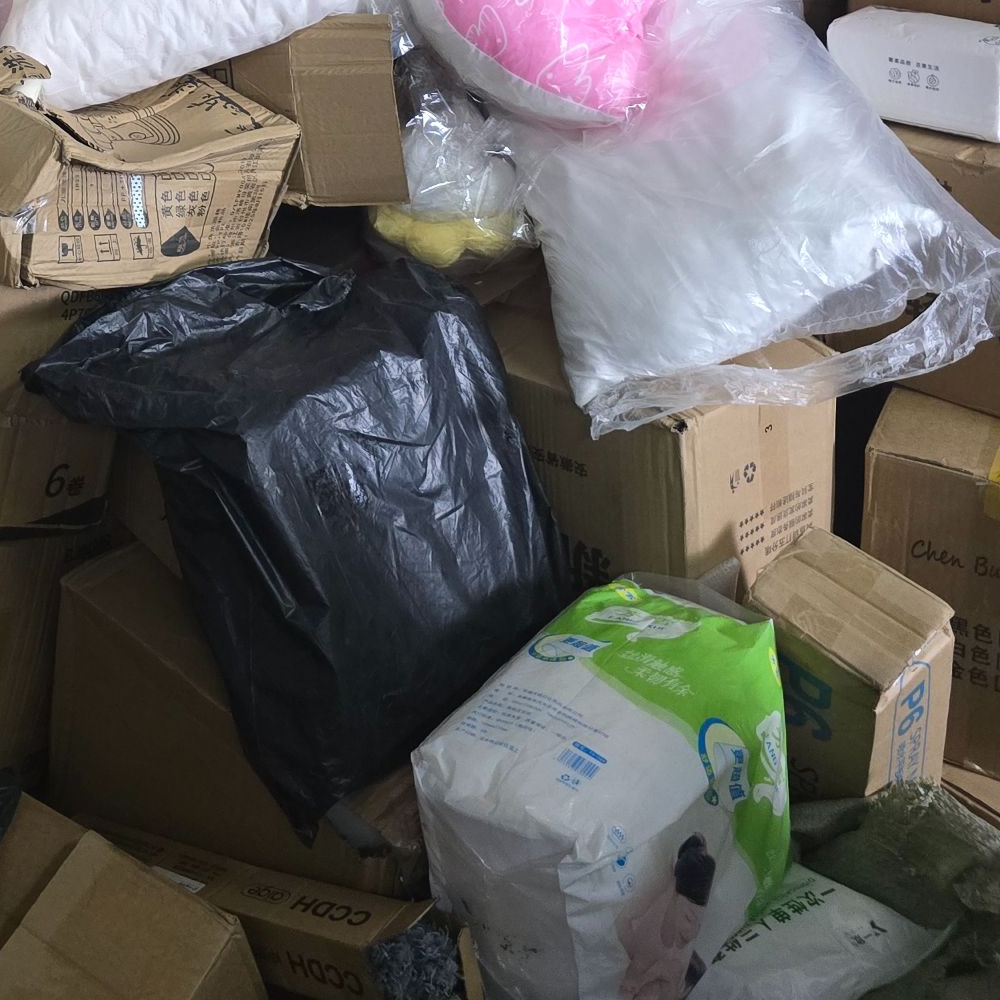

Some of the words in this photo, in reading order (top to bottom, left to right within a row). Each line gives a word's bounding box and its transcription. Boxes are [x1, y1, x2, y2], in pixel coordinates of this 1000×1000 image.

[161, 189, 174, 218] 黄色
[174, 189, 186, 218] 绿色
[186, 189, 199, 217] 灰色
[197, 190, 210, 217] 粉色
[909, 538, 965, 570] Chen
[897, 679, 926, 736] P6
[289, 888, 372, 928] CCDH
[287, 938, 366, 995] CCDH
